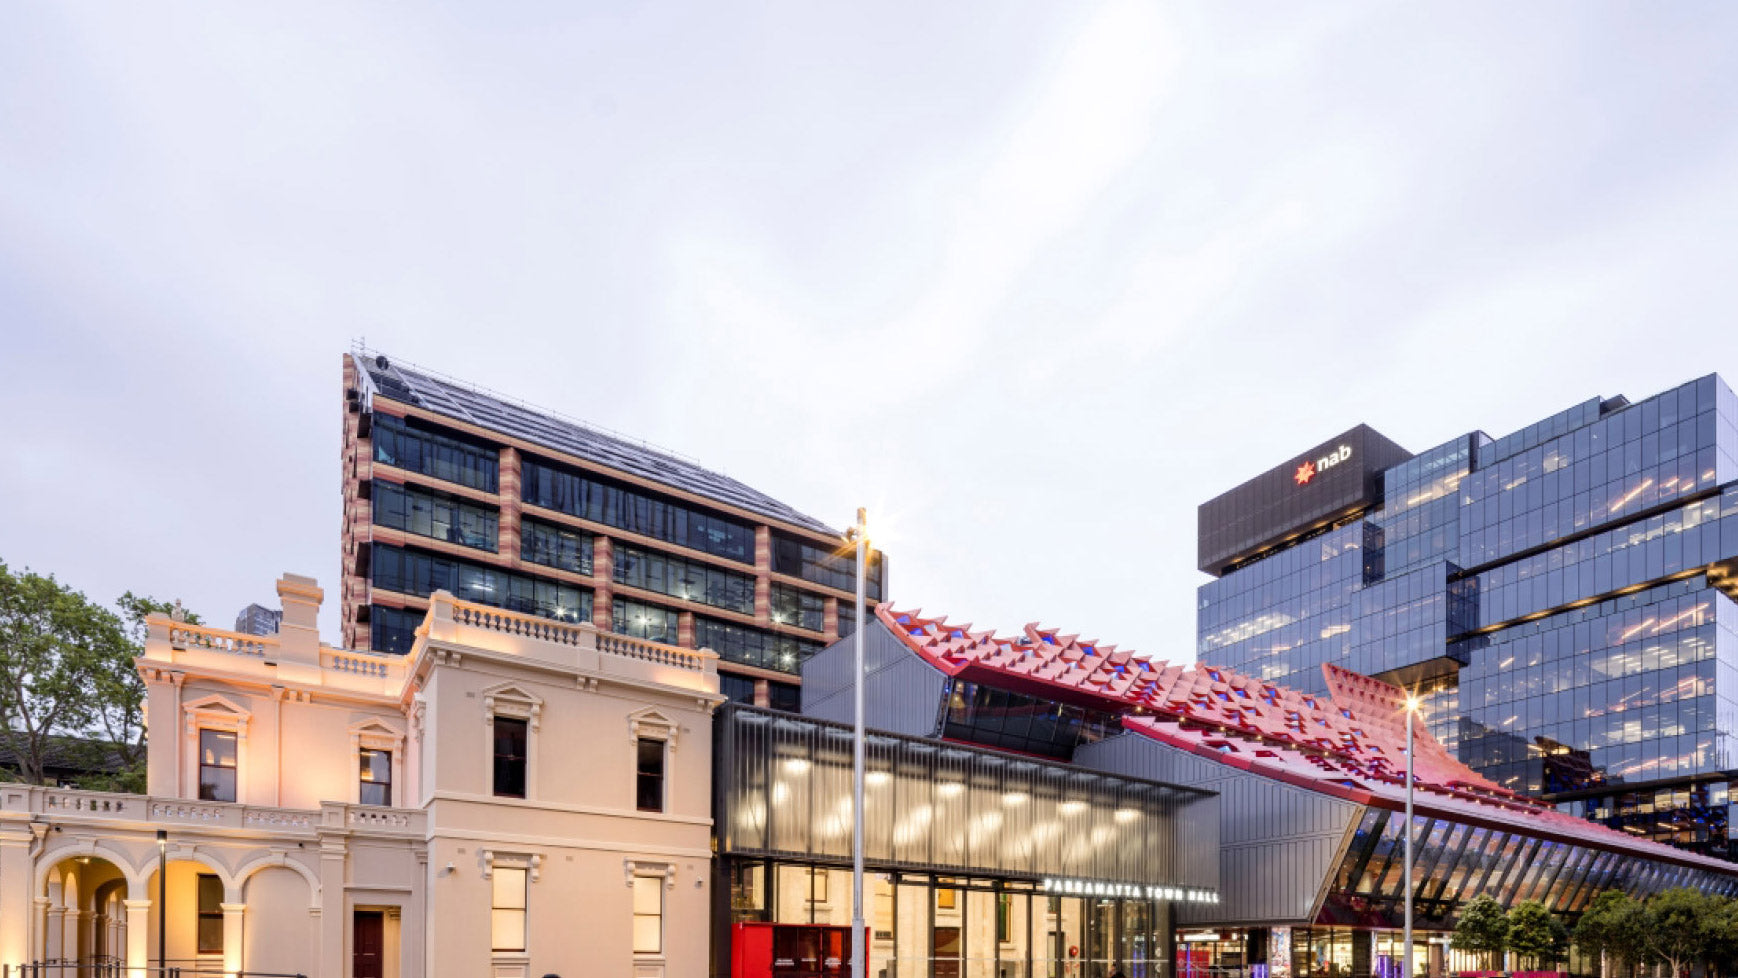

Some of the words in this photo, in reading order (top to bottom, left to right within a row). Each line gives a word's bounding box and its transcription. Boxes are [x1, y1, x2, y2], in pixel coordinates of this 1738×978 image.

[1317, 444, 1352, 472] nab
[1044, 878, 1141, 898] PARRAMATTA
[1146, 886, 1183, 900] TOWN
[1187, 889, 1219, 904] HALL
